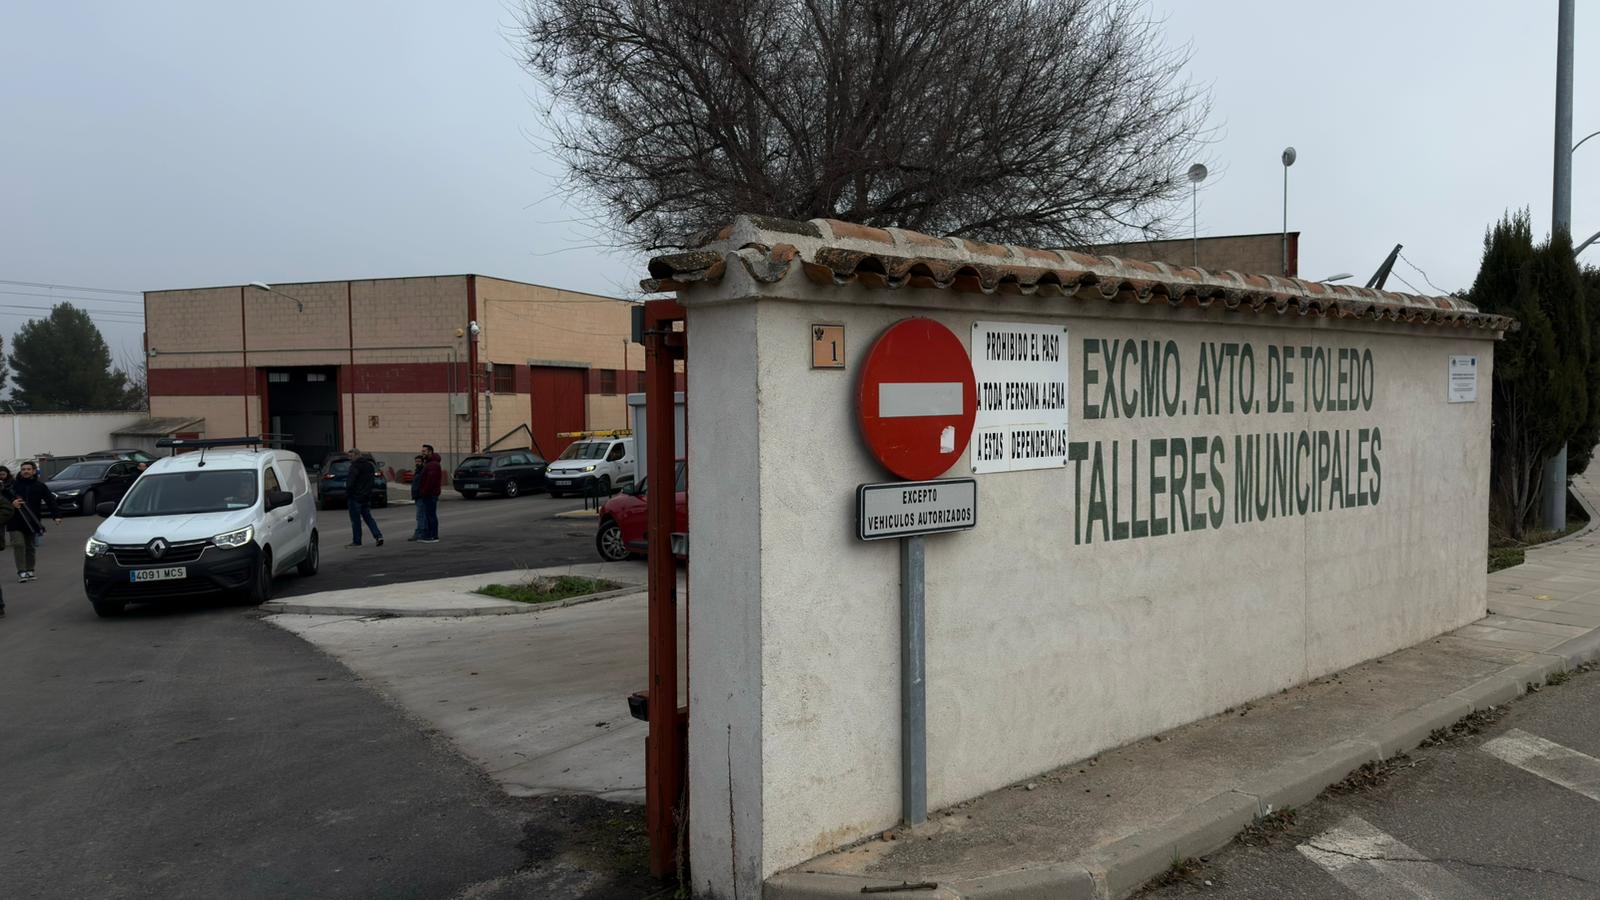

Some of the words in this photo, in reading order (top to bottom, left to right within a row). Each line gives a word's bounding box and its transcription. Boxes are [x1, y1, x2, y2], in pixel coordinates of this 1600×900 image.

[831, 340, 838, 362] 1
[987, 331, 1028, 361] PROHIBIDO
[1031, 333, 1040, 362] EL
[1042, 334, 1060, 362] PASO
[1083, 338, 1187, 420] EXCMO.
[1194, 342, 1260, 416] AYTO.
[1267, 344, 1295, 414] DE
[1301, 346, 1374, 413] TOLEDO
[976, 382, 981, 411] A
[983, 382, 1003, 411] TODA
[1005, 382, 1040, 410] PERSONA
[1042, 382, 1065, 410] AJENA
[977, 432, 982, 461] A
[984, 432, 1003, 461] ESTAS
[1011, 429, 1066, 460] DEPENDENCIAS
[902, 488, 938, 505] EXCEPTO
[1068, 435, 1225, 545] TALLERES
[1234, 426, 1382, 525] MUNICIPALES
[868, 513, 915, 531] VEHICULOS
[917, 507, 971, 526] AUTORIZADOS
[136, 570, 160, 580] 4091
[164, 568, 184, 578] MCS
